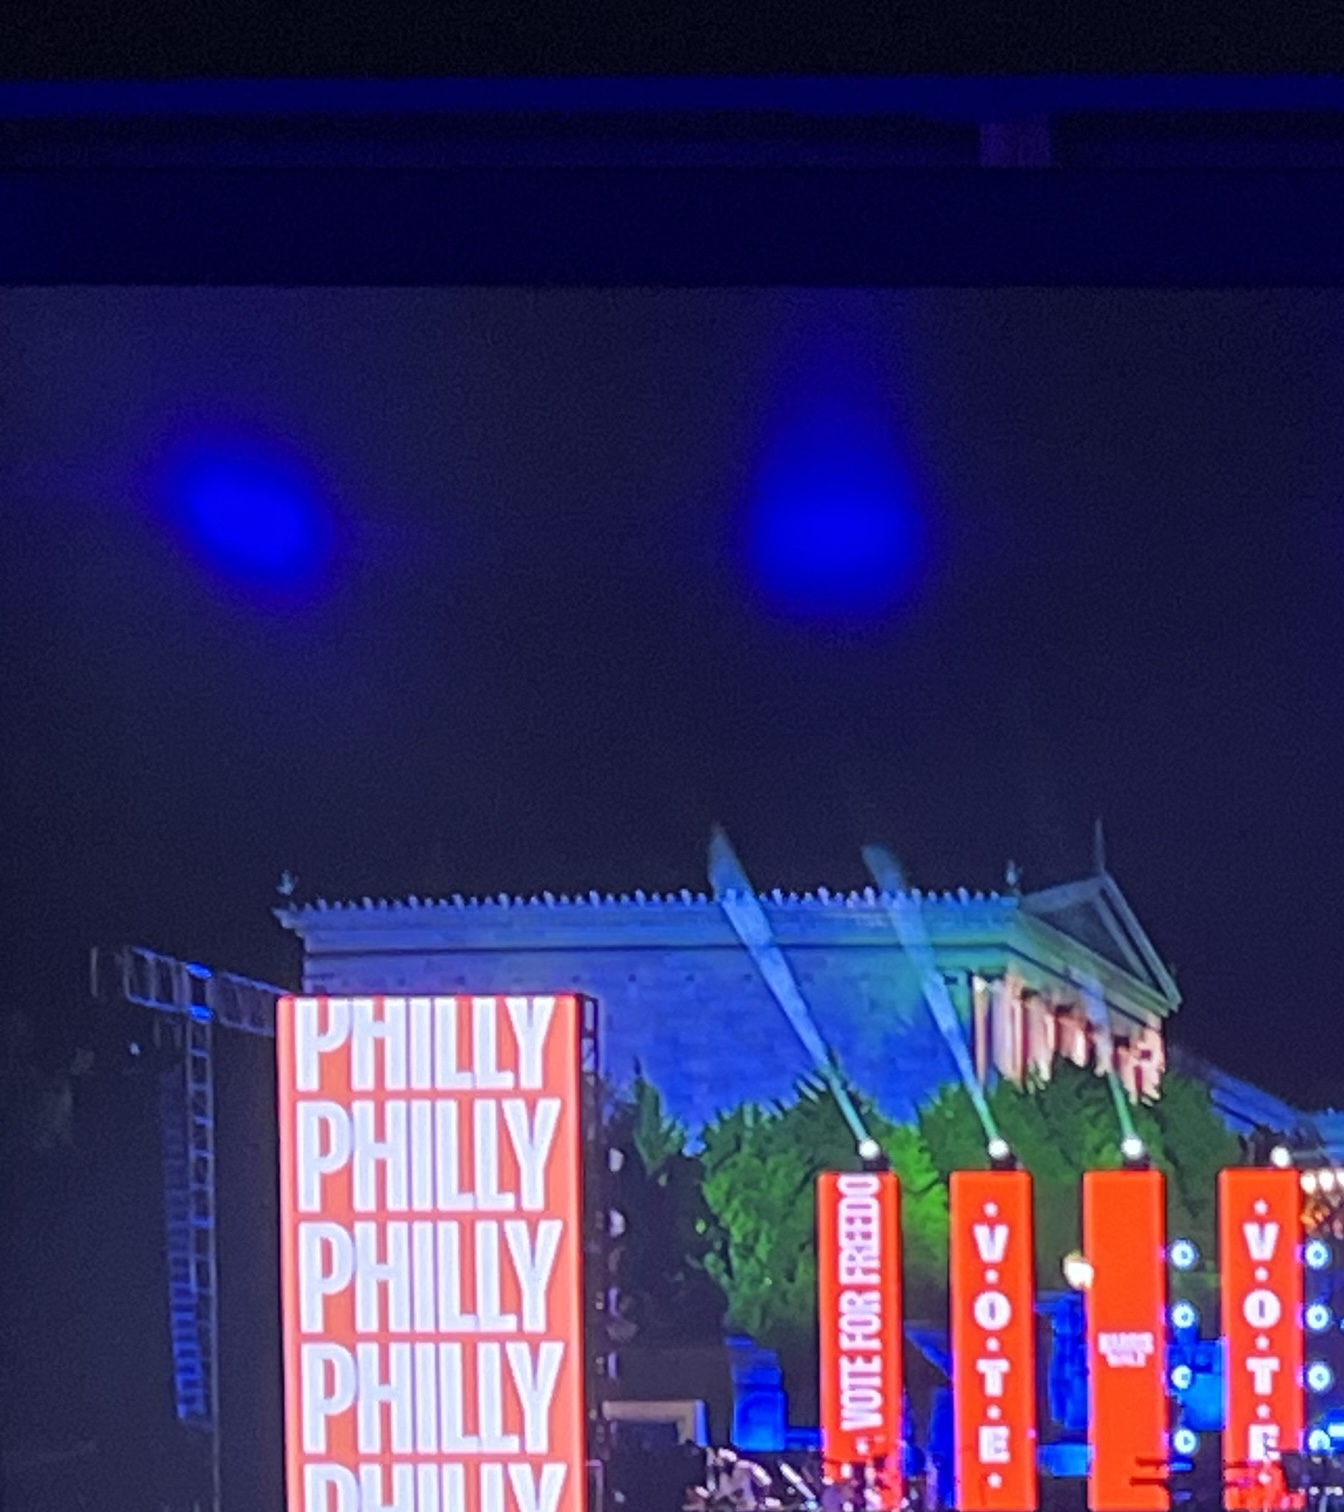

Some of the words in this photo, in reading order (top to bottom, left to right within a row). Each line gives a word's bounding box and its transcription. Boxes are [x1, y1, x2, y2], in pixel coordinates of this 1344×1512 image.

[295, 997, 555, 1092] PHILLY
[295, 1100, 562, 1212] PHILLY
[298, 1221, 563, 1334] PHILLY
[837, 1173, 881, 1285] FREEDO
[839, 1290, 882, 1350] FOR
[301, 1342, 565, 1455] PHILLY
[839, 1355, 882, 1432] VOTE
